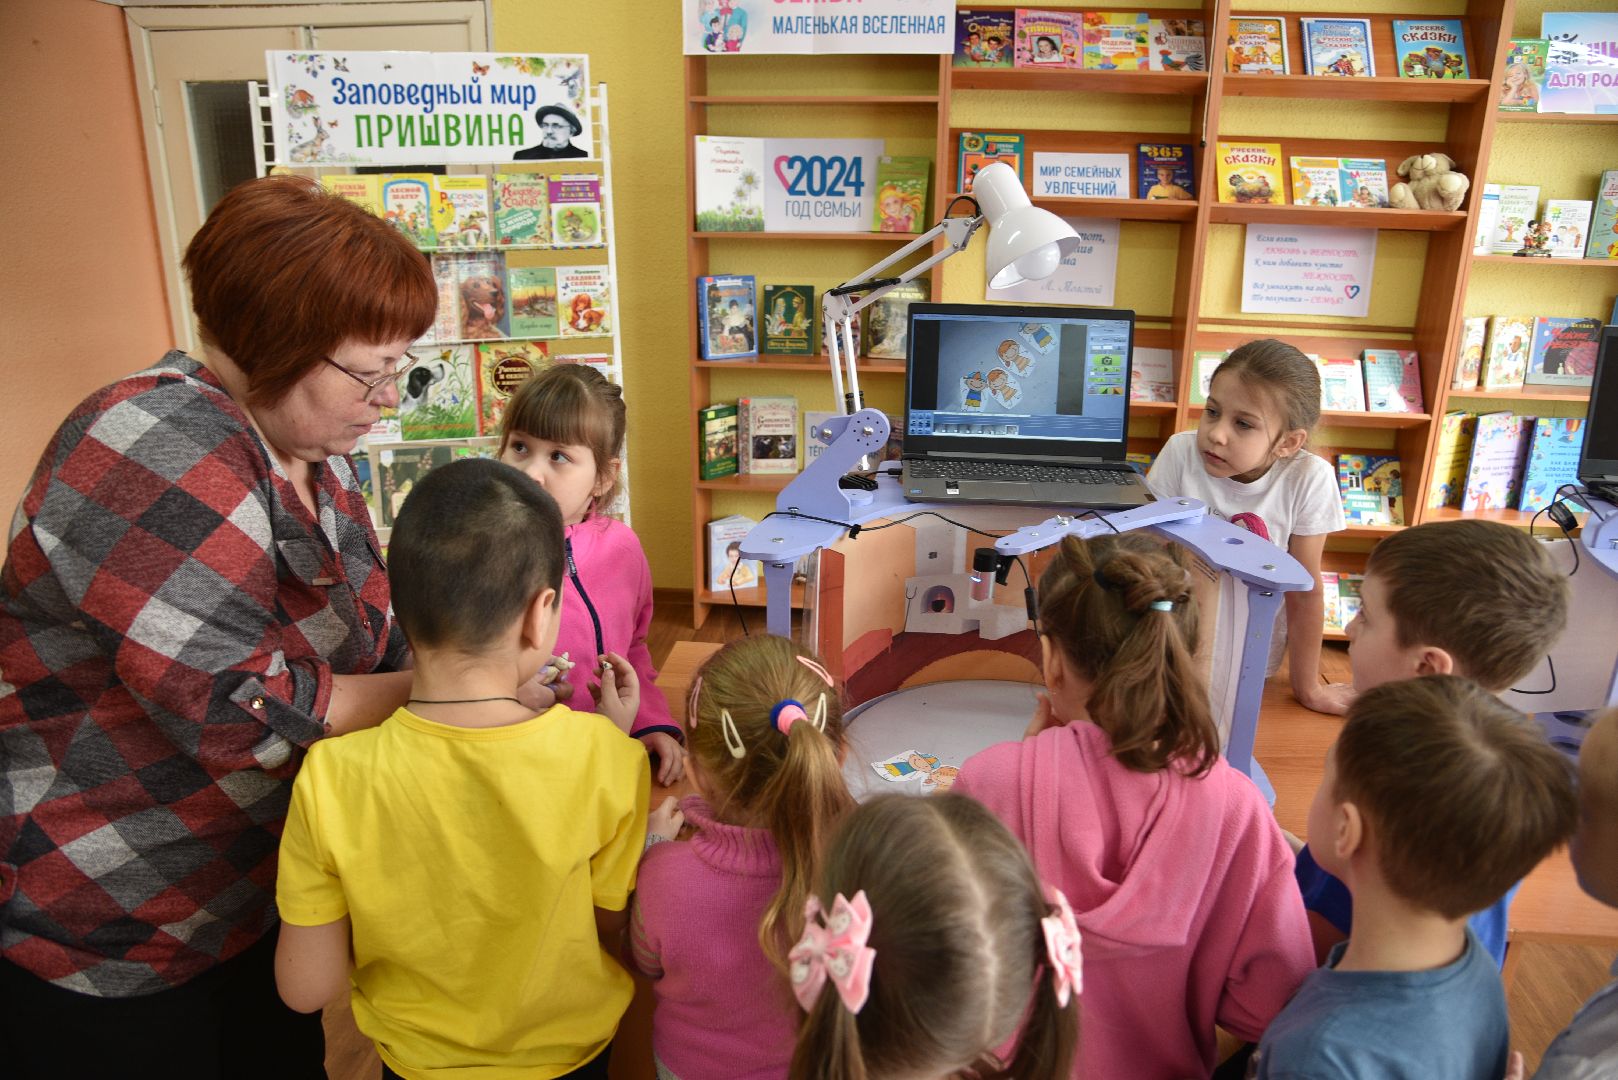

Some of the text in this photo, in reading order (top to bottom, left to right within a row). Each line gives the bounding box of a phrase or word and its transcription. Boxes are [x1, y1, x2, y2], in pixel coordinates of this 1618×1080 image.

[773, 15, 858, 34] МАЛЕНЬКАЯ
[863, 15, 945, 34] ВСЕЛЕННАЯ
[1402, 31, 1457, 43] СКАЗКИ
[1549, 72, 1586, 88] ДЛЯ
[331, 76, 537, 113] Заповедный мир
[355, 112, 525, 149] ПРИШВИНА
[1147, 146, 1183, 158] 365
[1224, 154, 1276, 167] СКАЗКИ
[787, 155, 864, 197] 2024
[1039, 165, 1122, 178] МИР СЕМЕЙНЫХ
[1044, 180, 1117, 197] УВЛЕЧЕНИЙ
[786, 200, 811, 219] ГОД
